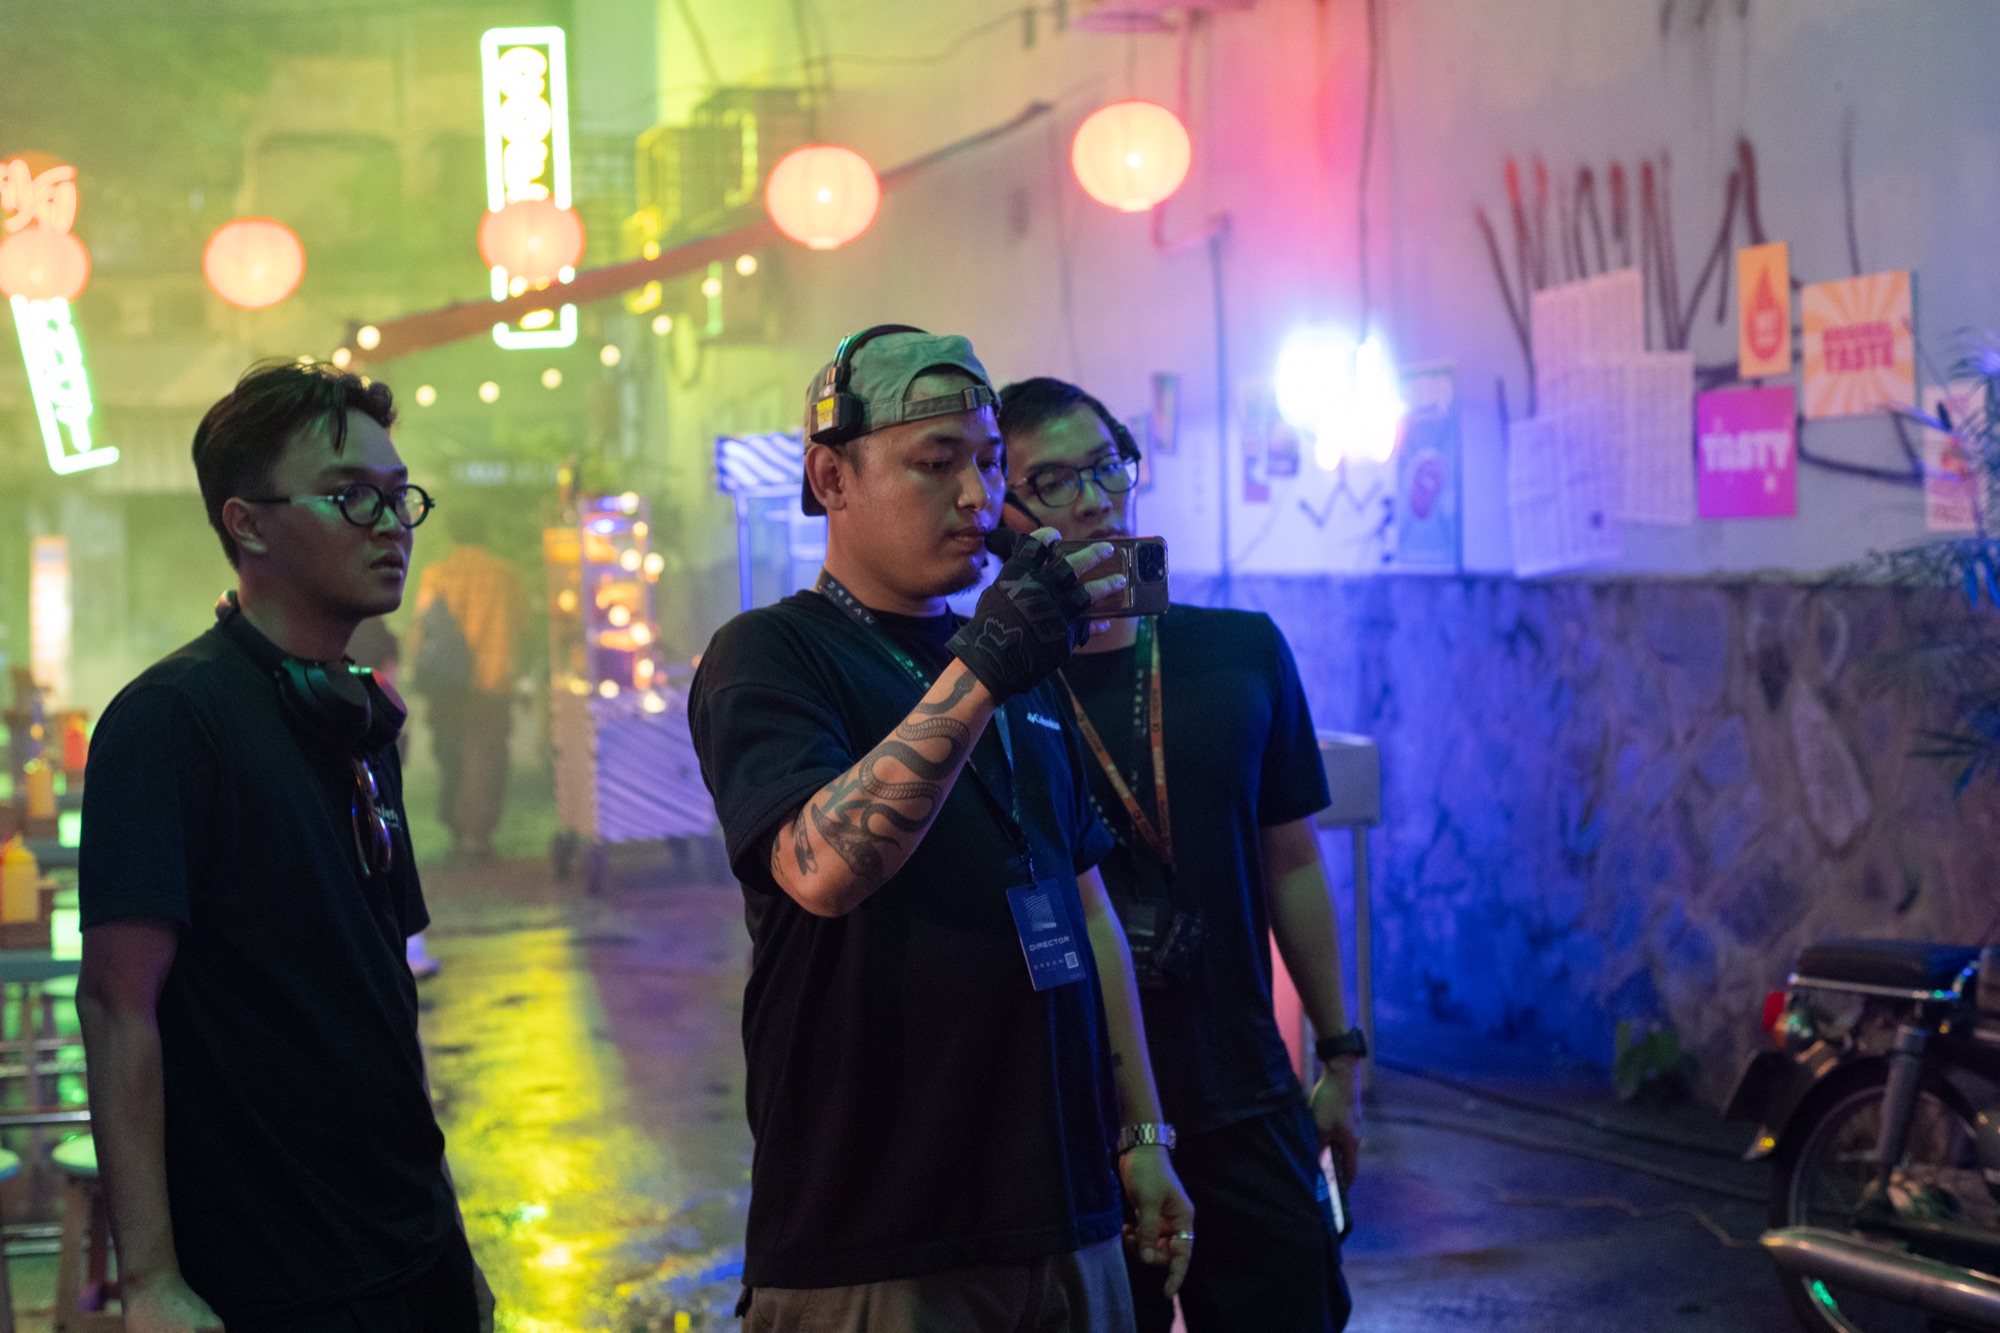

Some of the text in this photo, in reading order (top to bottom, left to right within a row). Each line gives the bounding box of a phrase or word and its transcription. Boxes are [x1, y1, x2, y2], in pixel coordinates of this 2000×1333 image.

[1824, 339, 1894, 374] TASTE
[1702, 431, 1790, 471] TASTY
[1029, 936, 1070, 952] DIRECTOR
